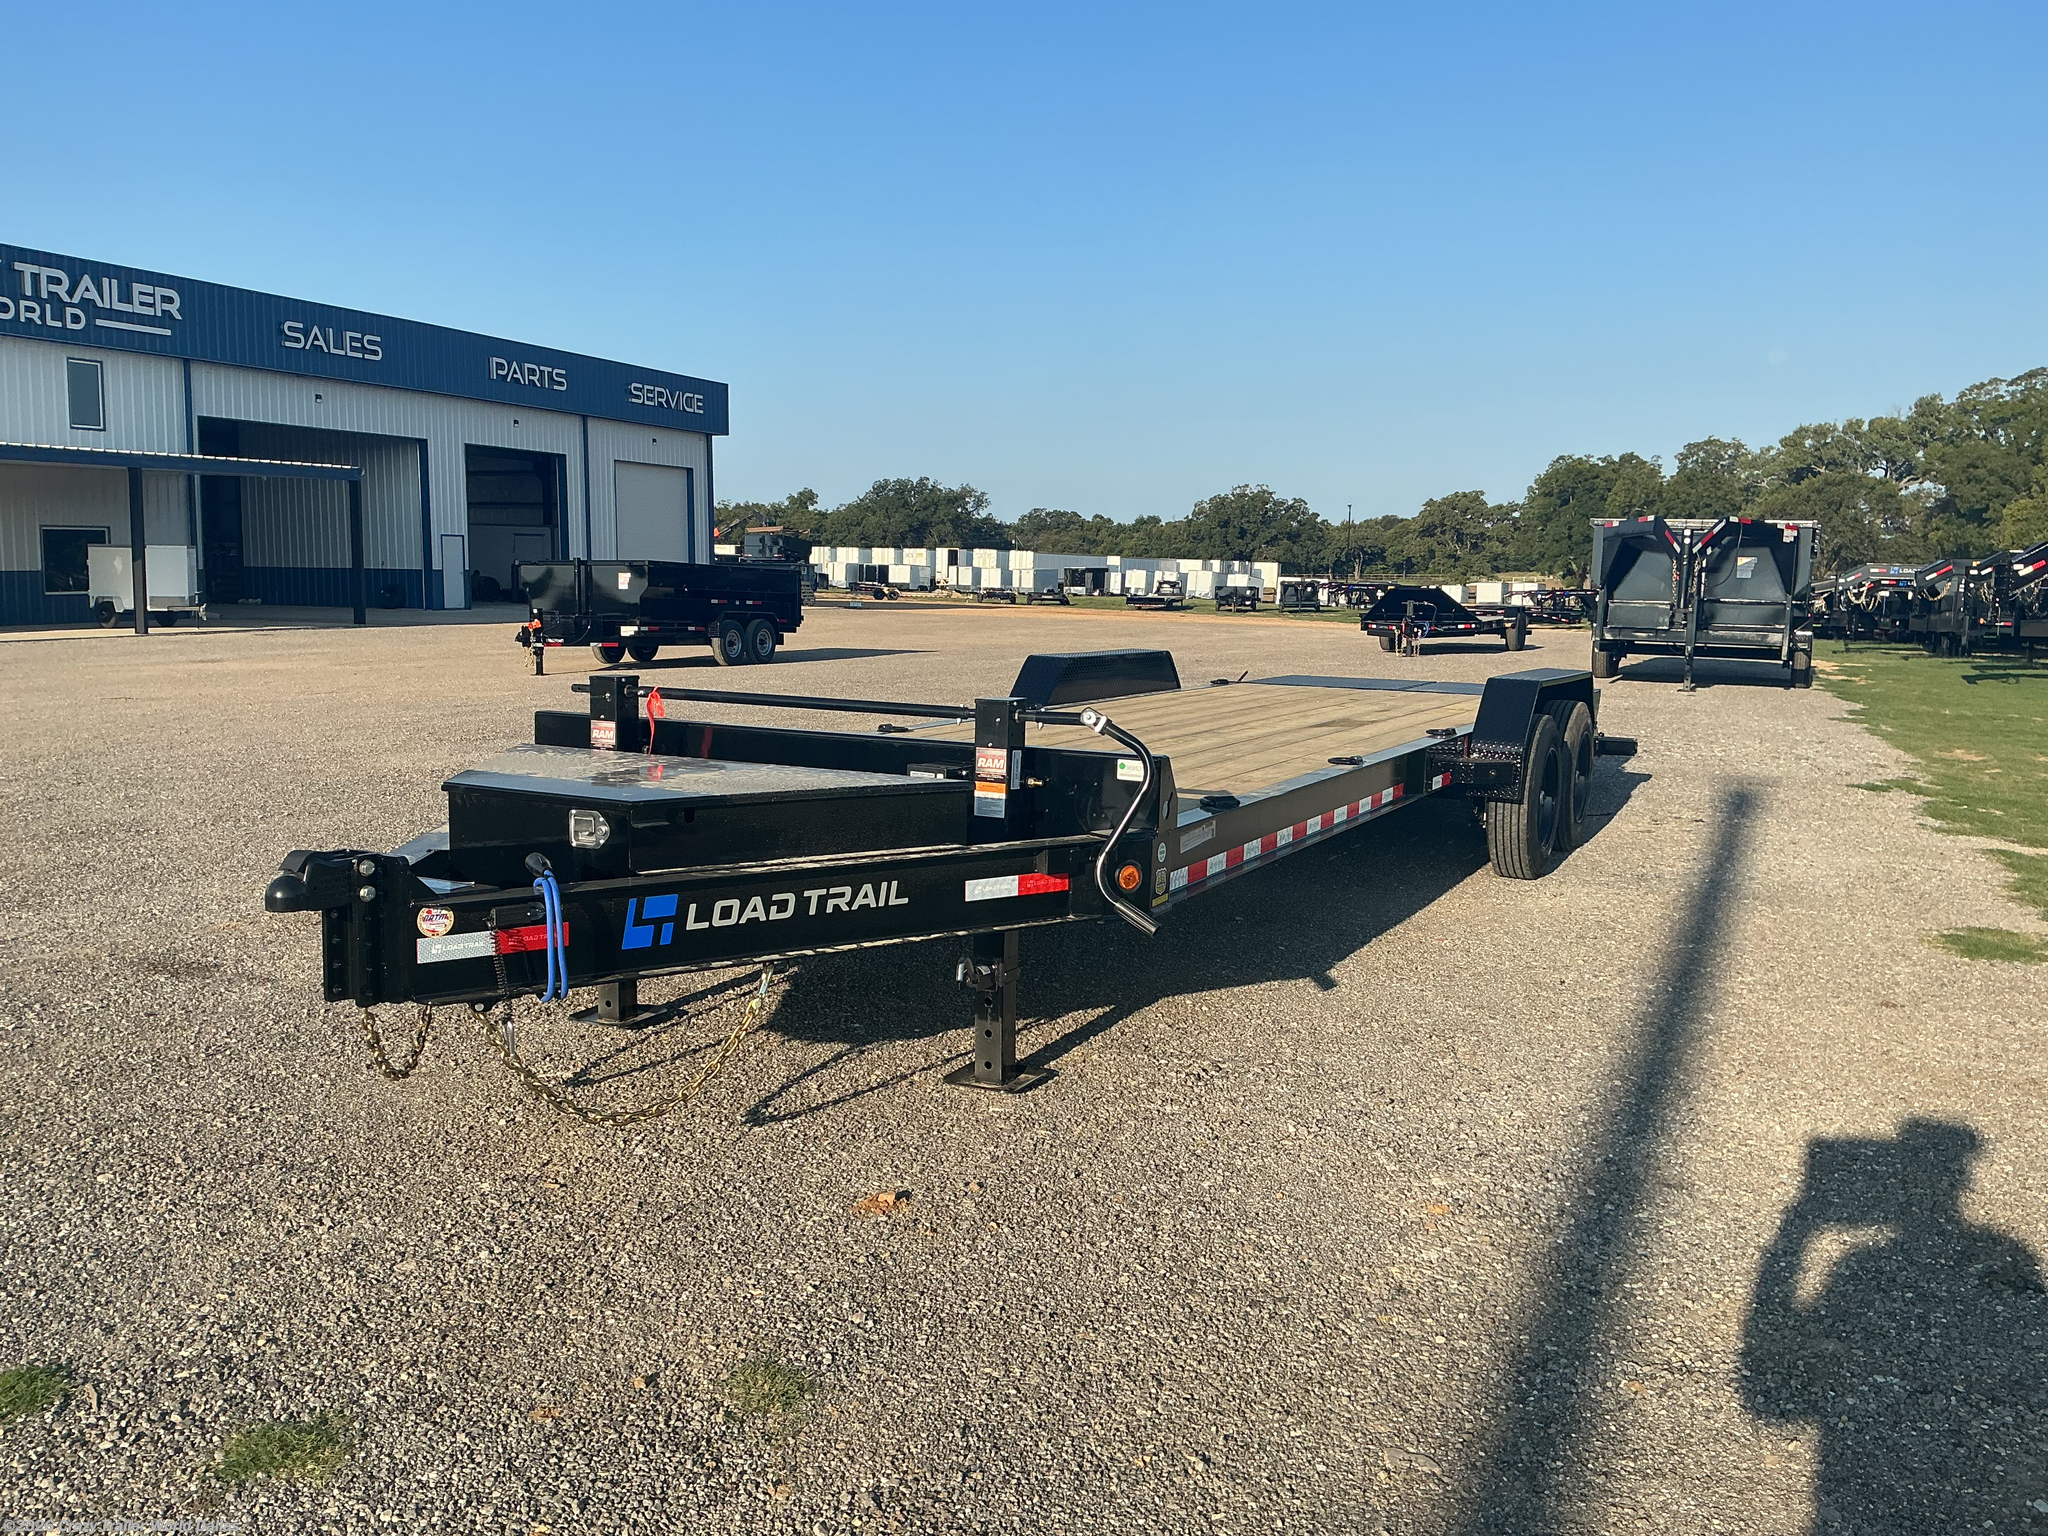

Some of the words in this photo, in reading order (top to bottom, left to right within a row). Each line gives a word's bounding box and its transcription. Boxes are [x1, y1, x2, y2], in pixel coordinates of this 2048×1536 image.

[12, 261, 183, 320] TRAILER
[282, 320, 383, 361] SALES
[488, 356, 567, 391] PARTS
[628, 382, 704, 414] SERVICE
[592, 728, 614, 740] RAM
[977, 757, 1005, 769] RAM
[685, 892, 795, 931] LOAD
[803, 879, 909, 916] TRAIL
[442, 943, 463, 951] LOAD
